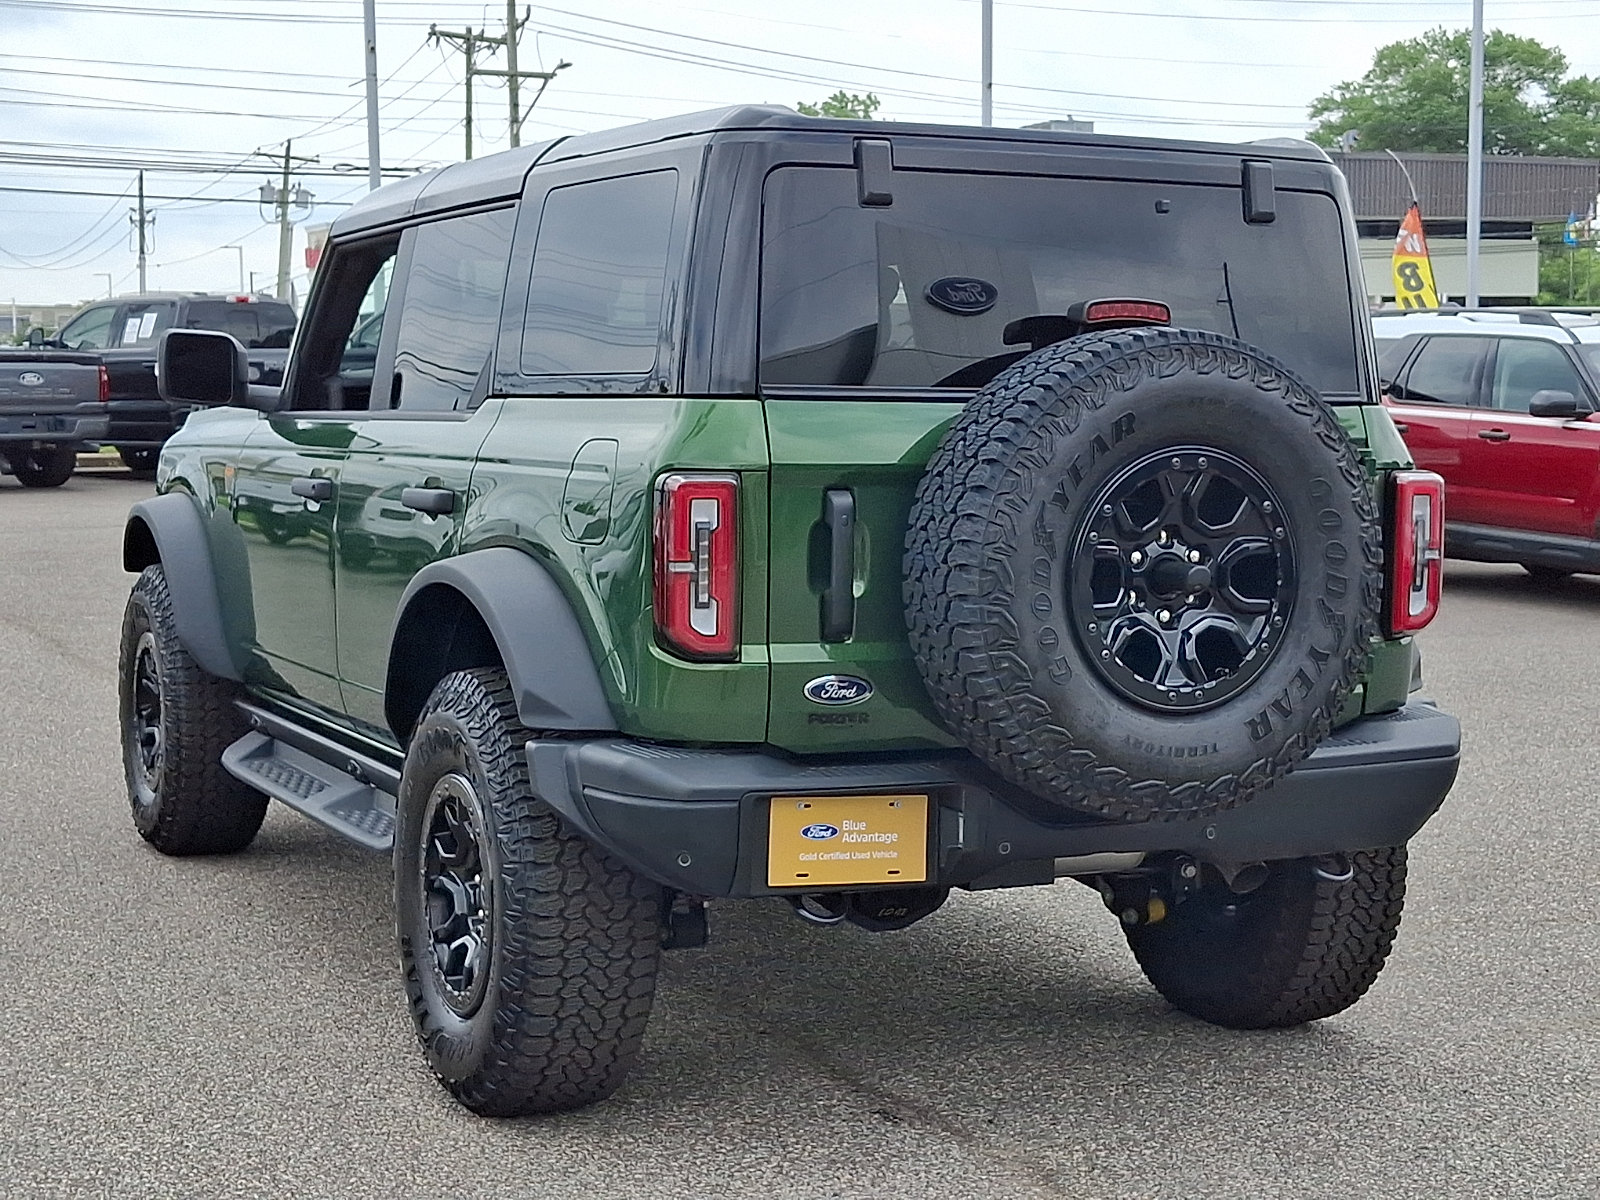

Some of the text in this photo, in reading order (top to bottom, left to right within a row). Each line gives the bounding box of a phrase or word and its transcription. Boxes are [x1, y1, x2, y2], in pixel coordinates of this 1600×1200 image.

[820, 681, 858, 699] Ford
[806, 825, 834, 838] Ford
[842, 820, 867, 831] Blue
[842, 832, 898, 844] Advantage
[799, 849, 898, 861] Gold Certified Used Vehicle
